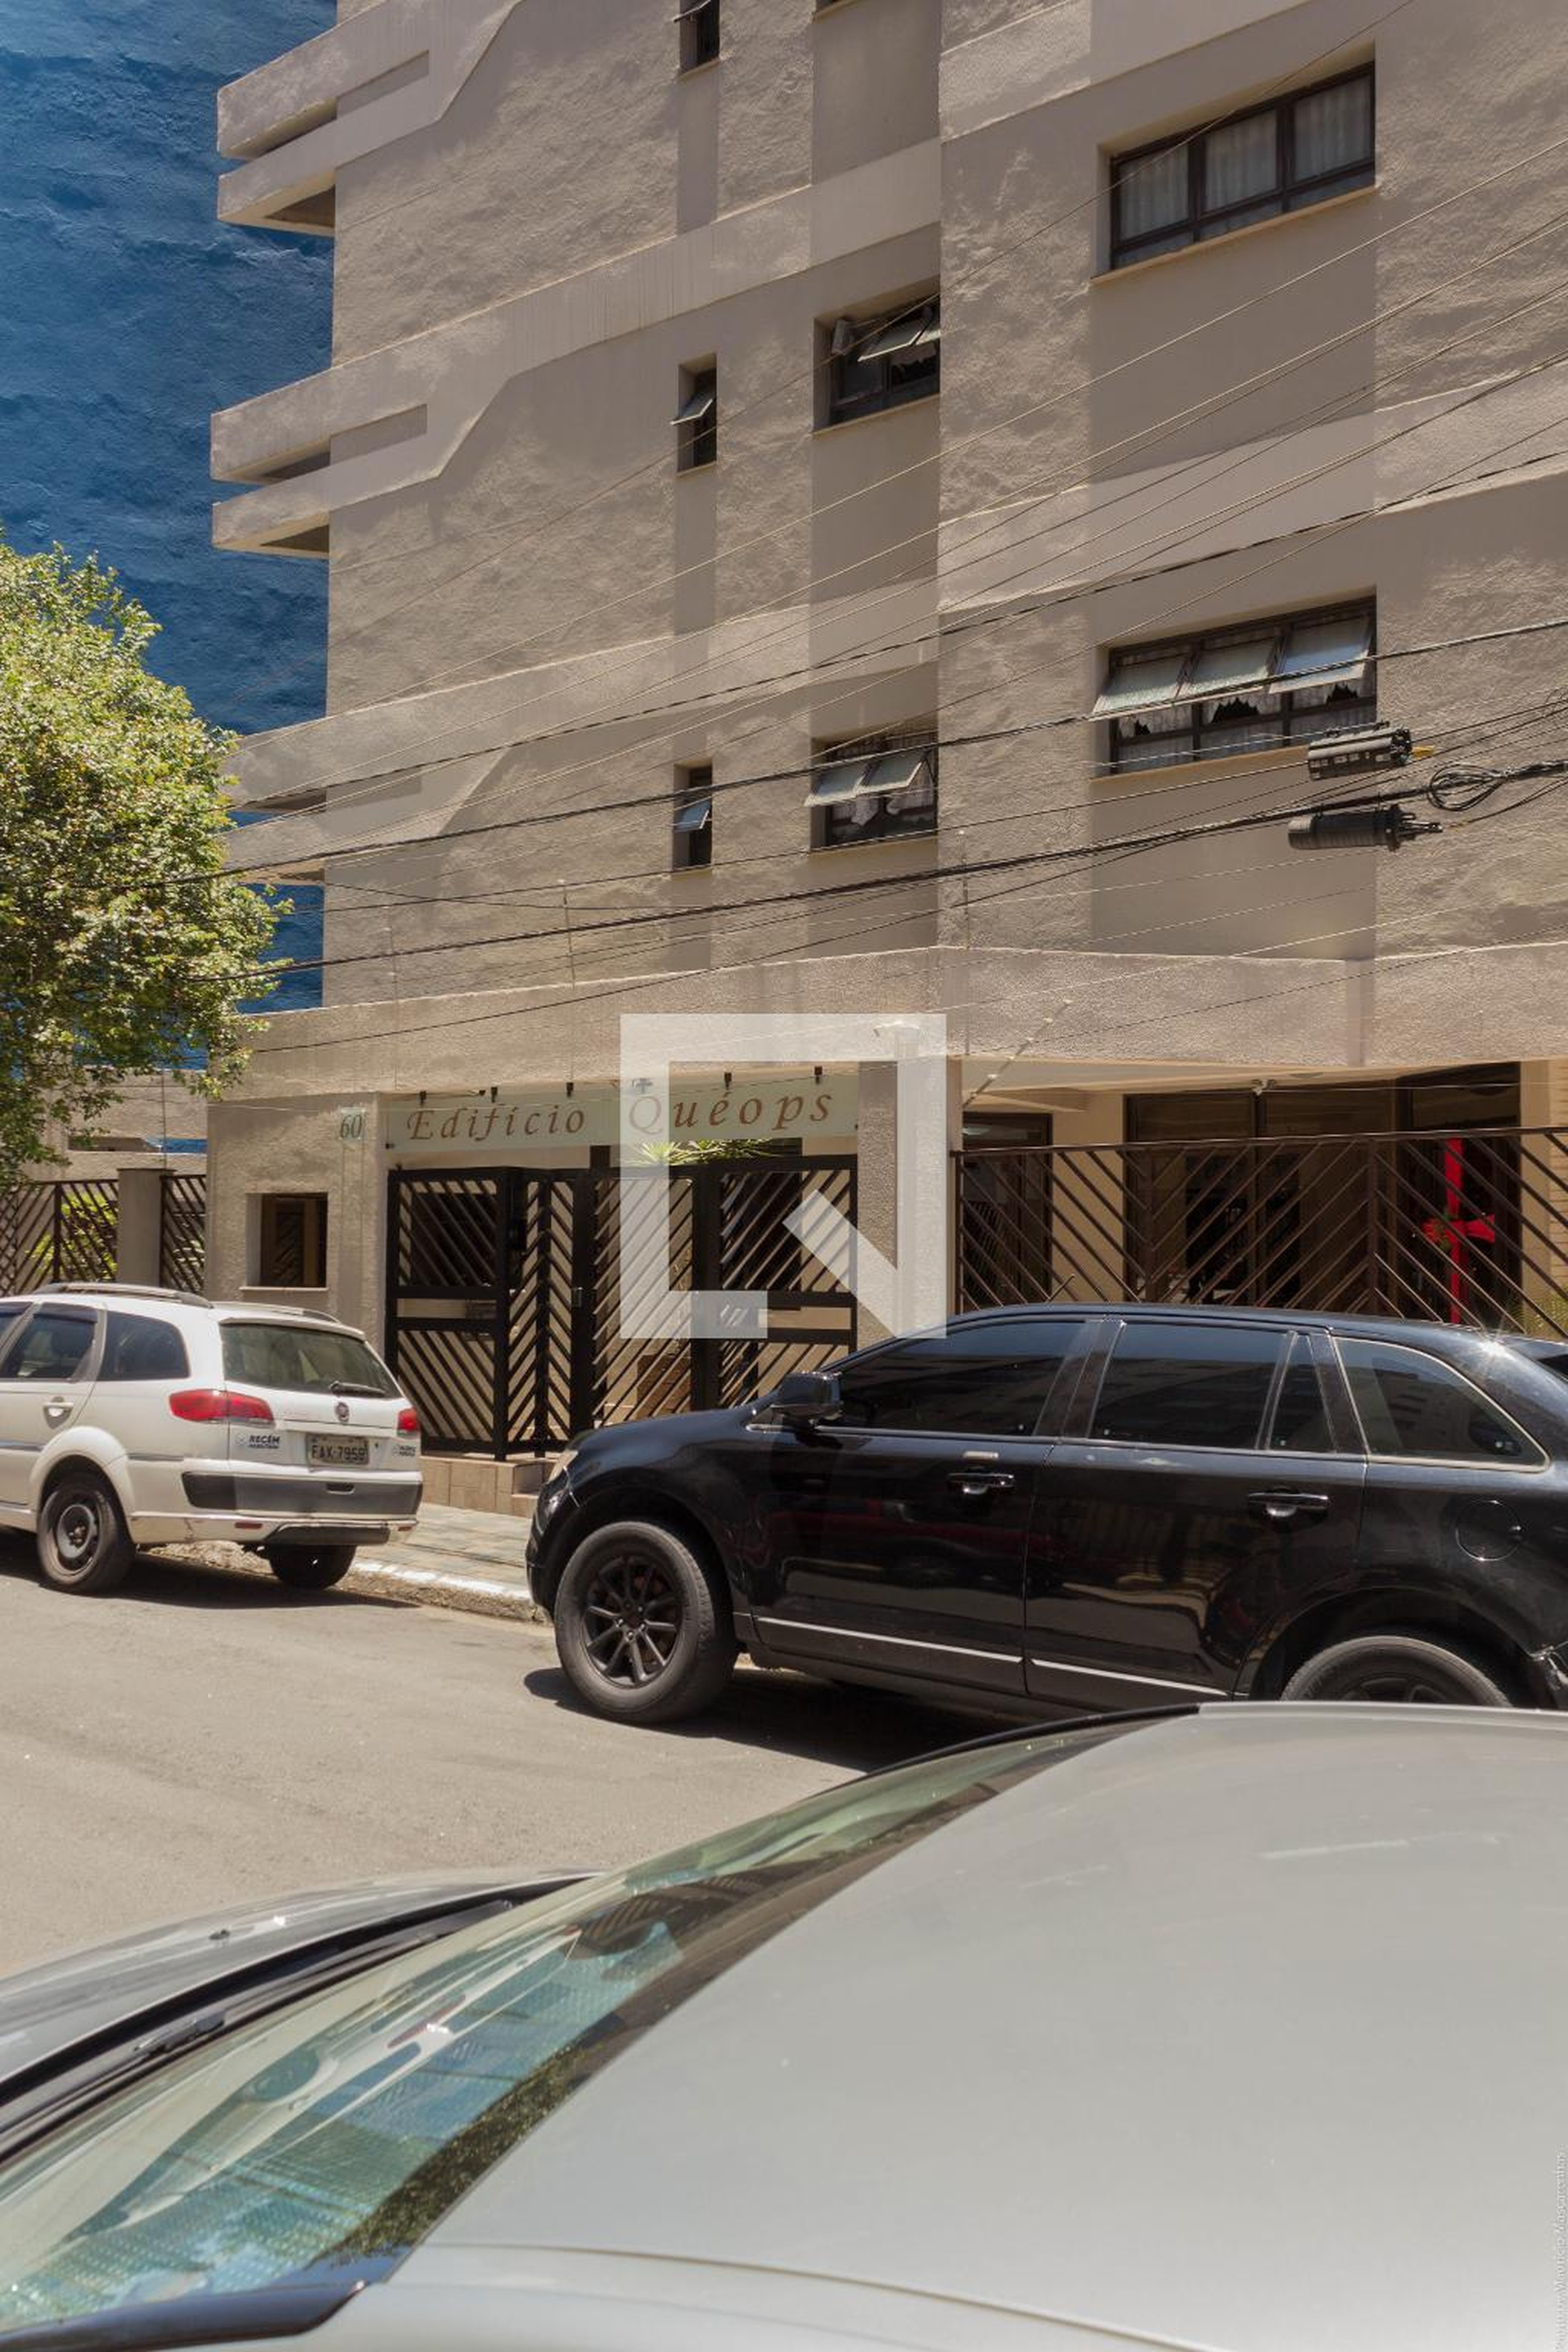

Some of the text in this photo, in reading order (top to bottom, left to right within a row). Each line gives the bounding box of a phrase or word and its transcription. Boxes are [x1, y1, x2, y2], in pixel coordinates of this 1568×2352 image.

[341, 1114, 362, 1138] 60
[407, 1092, 832, 1142] Edifício Quéops
